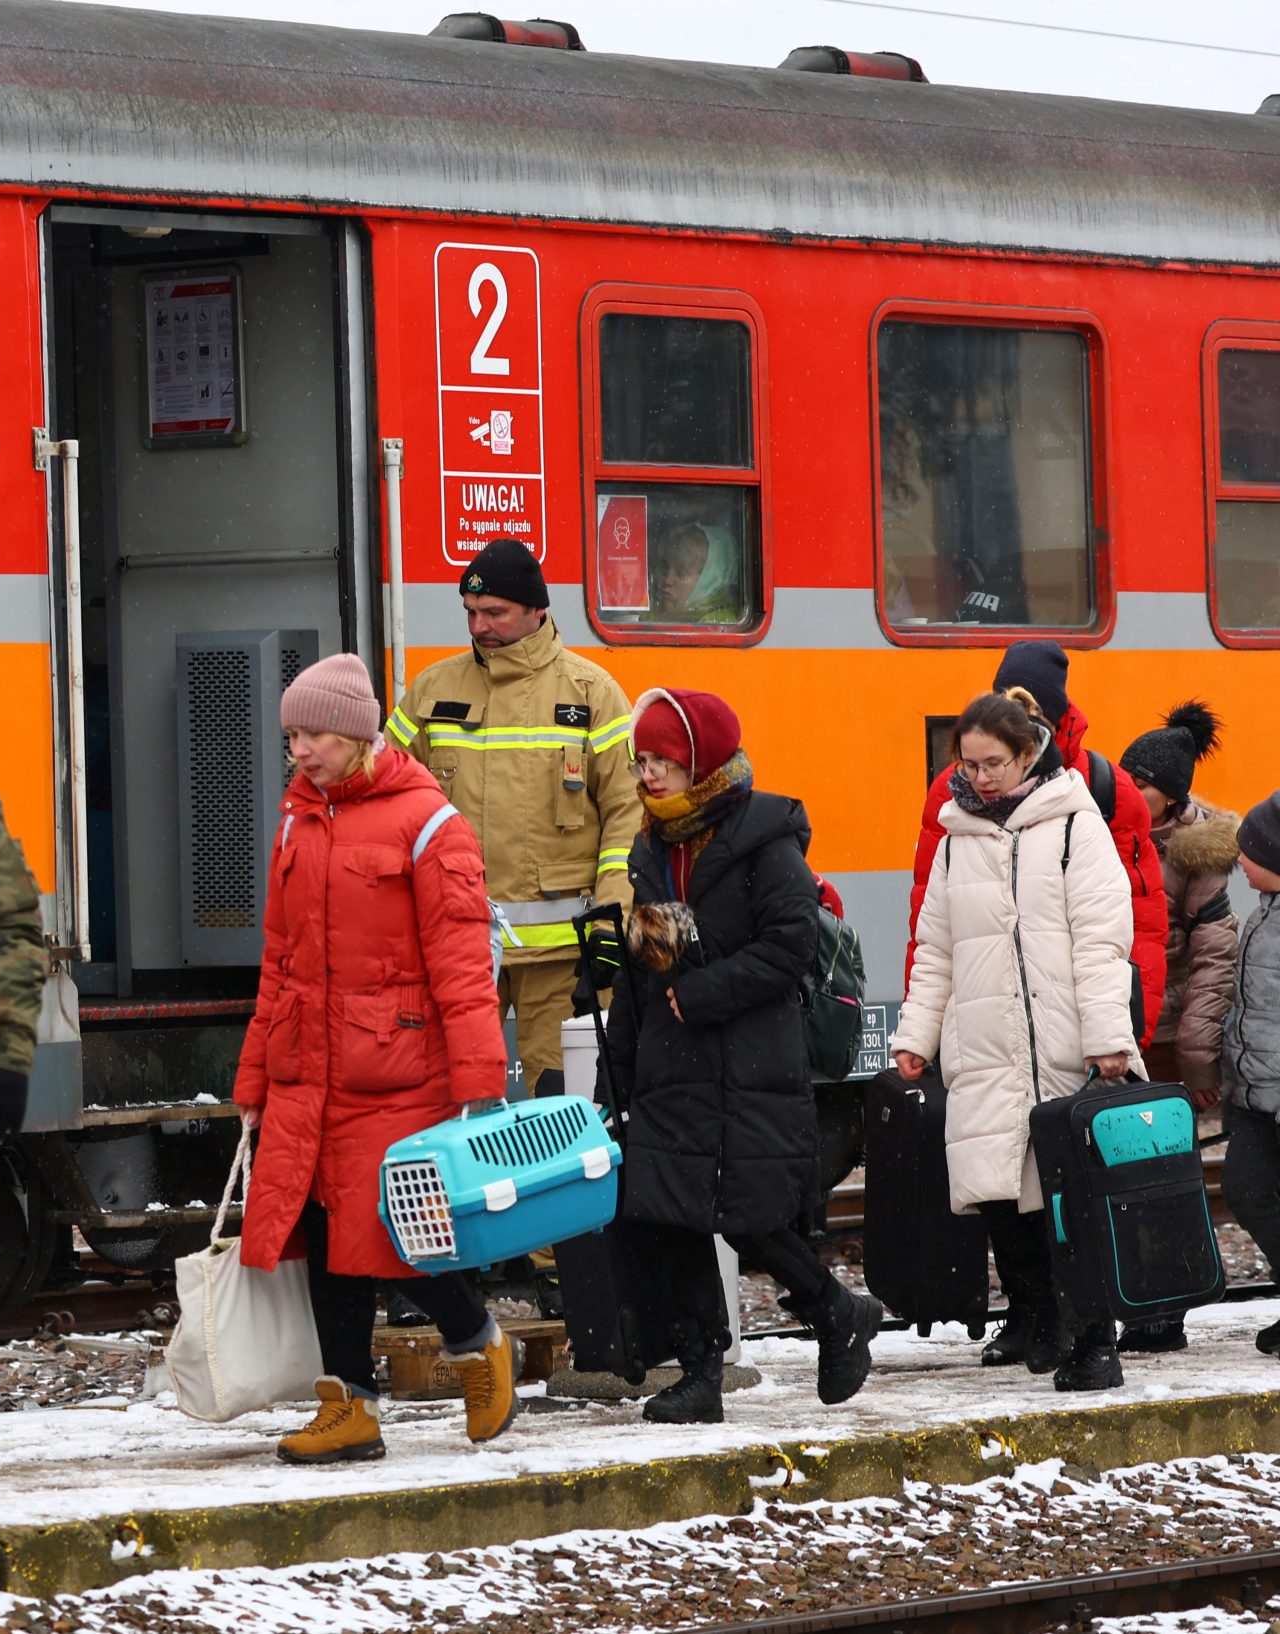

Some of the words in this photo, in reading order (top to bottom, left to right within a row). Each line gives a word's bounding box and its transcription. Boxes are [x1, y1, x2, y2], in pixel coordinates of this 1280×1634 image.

[468, 262, 510, 376] 2
[462, 483, 525, 513] UWAGA!
[459, 517, 470, 532] Po
[472, 519, 500, 534] sygnale
[503, 519, 531, 536] odjazdu
[456, 537, 491, 551] wsiadani
